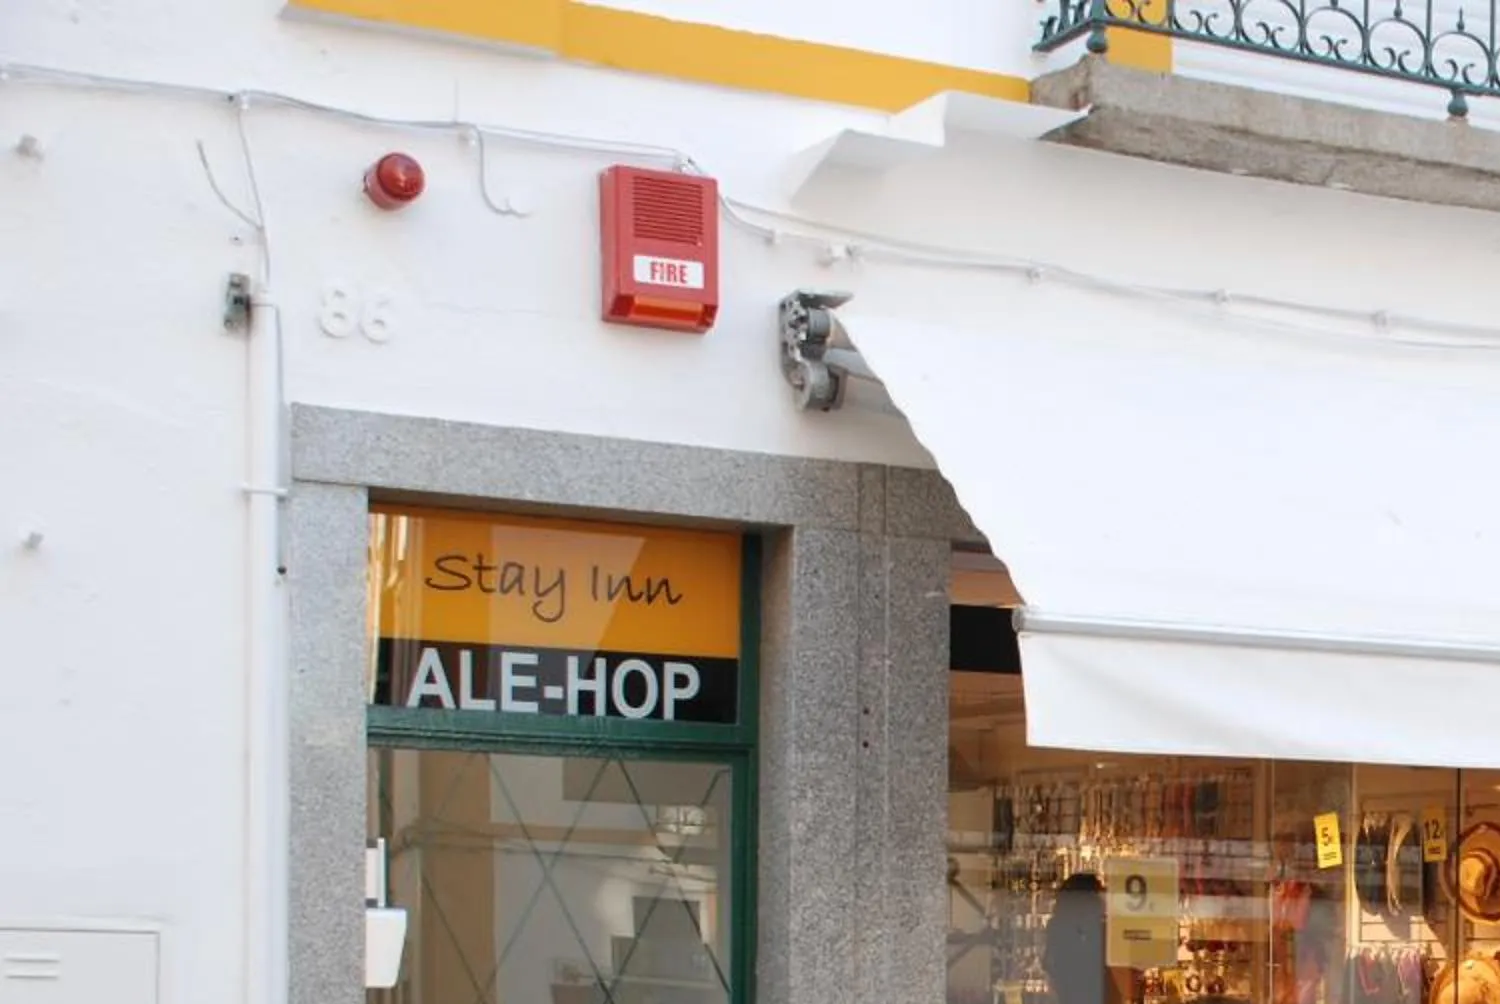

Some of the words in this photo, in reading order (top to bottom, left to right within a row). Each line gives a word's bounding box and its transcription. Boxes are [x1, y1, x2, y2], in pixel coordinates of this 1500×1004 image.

[649, 260, 689, 285] FIRE
[318, 282, 395, 344] 86
[424, 553, 566, 623] Stay
[591, 565, 683, 605] Inn
[405, 647, 701, 721] ALE-HOP
